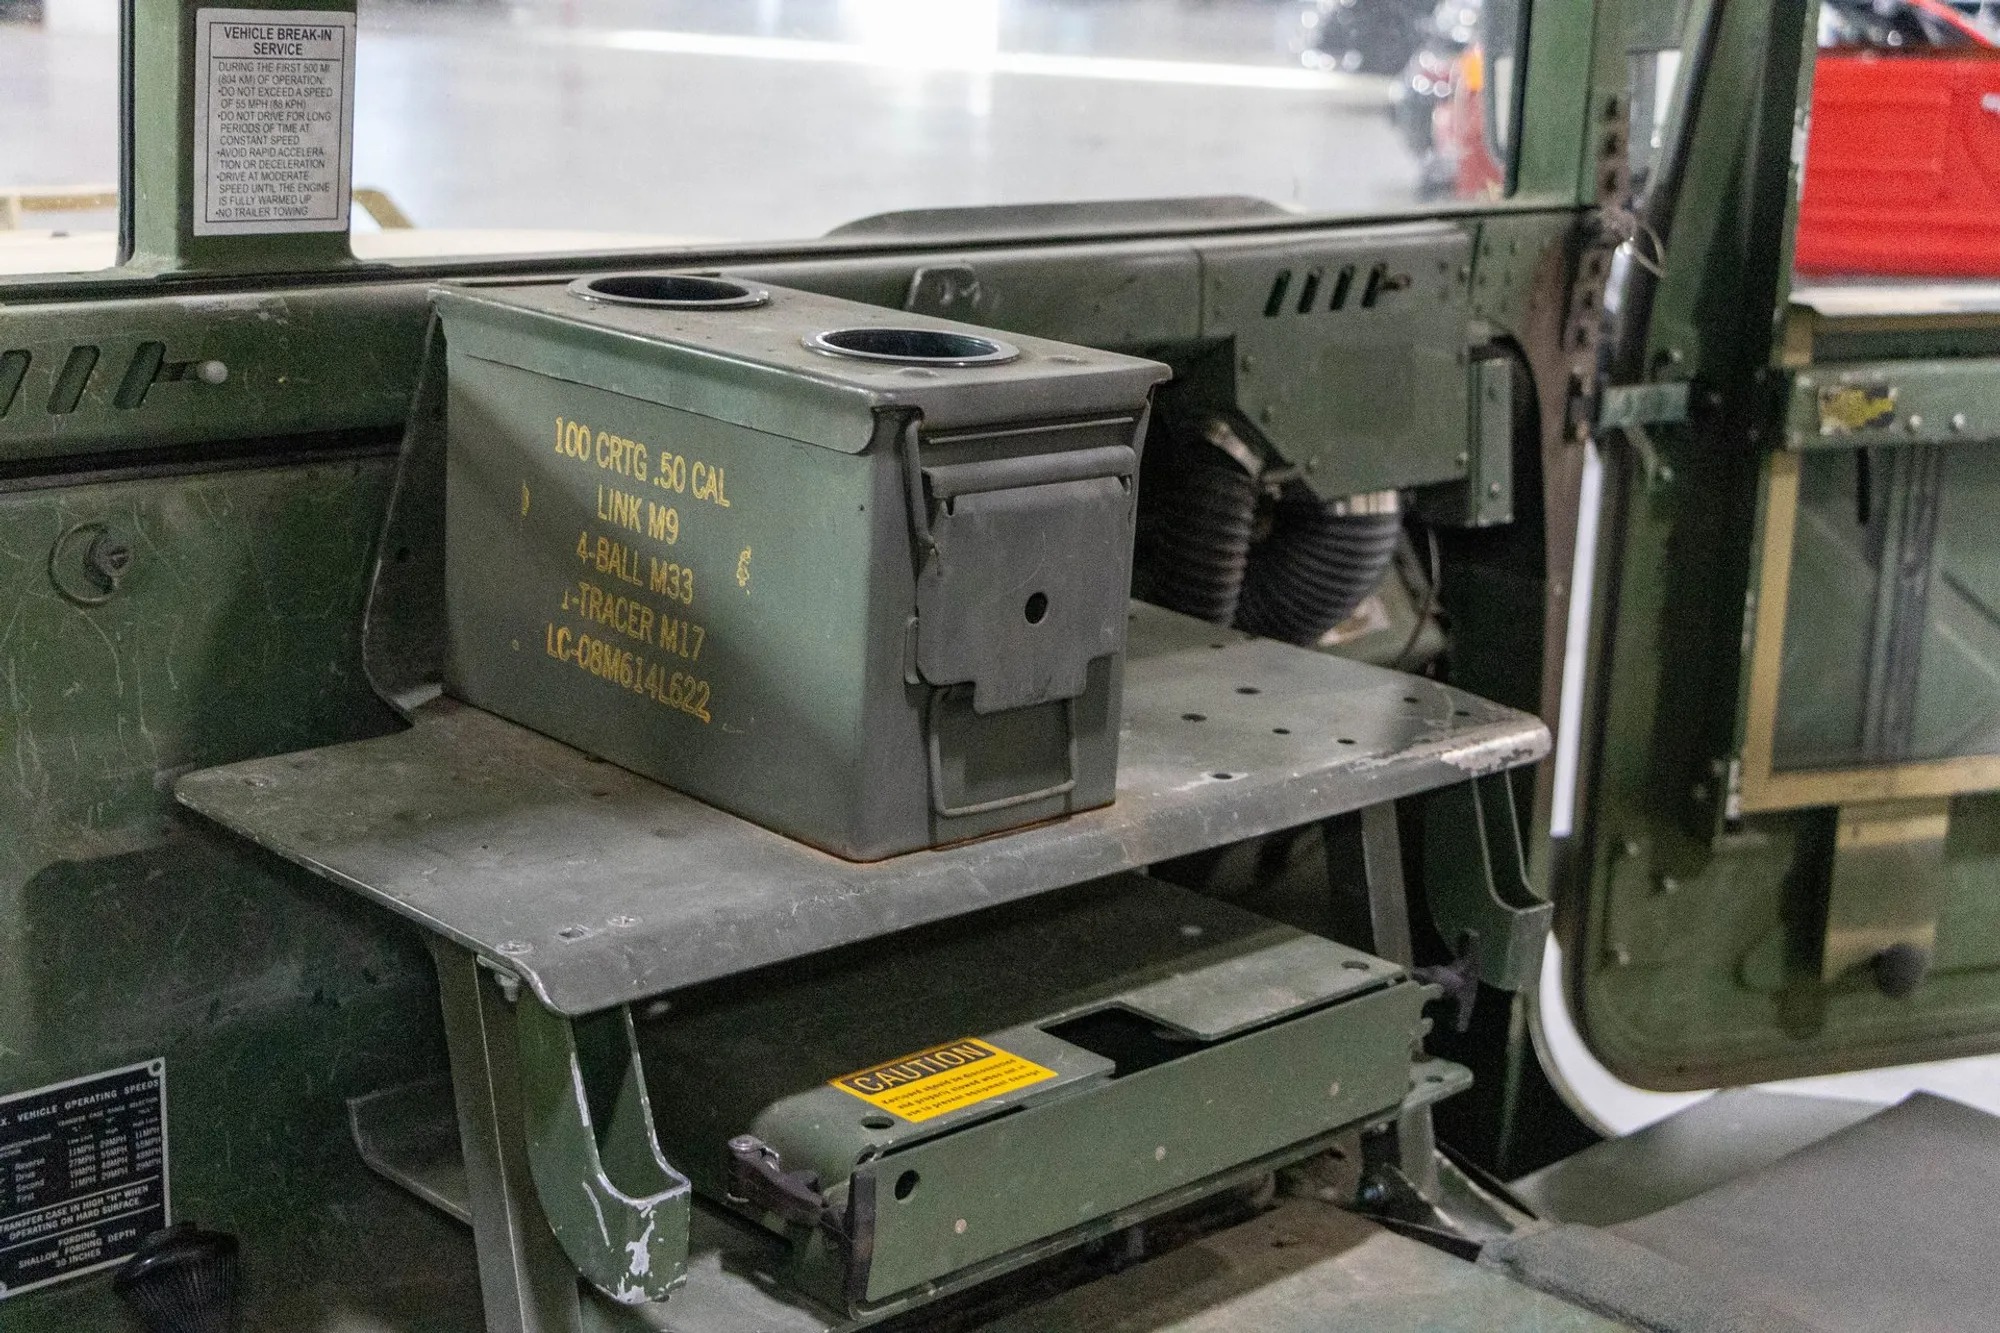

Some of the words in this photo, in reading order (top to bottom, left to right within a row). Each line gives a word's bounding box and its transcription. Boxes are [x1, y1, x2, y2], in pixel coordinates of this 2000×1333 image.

[224, 26, 274, 40] VEHICLE
[277, 28, 332, 41] BREAK-IN
[253, 42, 303, 55] SERVICE
[218, 62, 253, 73] DURING
[256, 62, 274, 73] THE
[276, 63, 300, 73] FIRST
[304, 63, 318, 73] 500
[257, 75, 270, 85] OF
[237, 87, 255, 97] NOT
[258, 87, 294, 97] EXCEED
[295, 88, 303, 97] A
[304, 87, 333, 97] SPEED
[221, 99, 233, 109] OF
[235, 99, 246, 109] 55
[249, 99, 267, 109] MPH
[285, 99, 307, 110] KPH)
[236, 111, 255, 121] NOT
[258, 111, 284, 121] DRIVE
[286, 112, 305, 121] FOR
[307, 112, 331, 122] LONG
[220, 123, 261, 133] PERIODS
[263, 123, 275, 133] OF
[278, 123, 298, 133] TIME
[300, 123, 310, 133] AT
[219, 135, 267, 145] CONSTANT
[270, 135, 300, 145] SPEED
[249, 148, 277, 157] RAPID
[220, 160, 241, 169] TION
[243, 160, 256, 169] OR
[259, 159, 325, 169] DECELERATION
[248, 172, 259, 181] AT
[261, 171, 309, 181] MODERATE
[219, 184, 249, 194] SPEED
[251, 184, 277, 193] UNTIL
[279, 183, 295, 192] THE
[297, 183, 330, 192] ENGINE
[218, 196, 227, 206] IS
[229, 196, 256, 205] FULLY
[258, 195, 298, 205] WARMED
[300, 195, 312, 204] UP
[235, 208, 270, 217] TRAILER
[273, 206, 308, 217] TOWING
[554, 416, 591, 462] 100
[596, 431, 647, 482] CRTG
[653, 452, 687, 494] .50
[691, 461, 731, 508] CAL
[597, 484, 643, 533] LINK
[648, 502, 680, 545] M9
[576, 531, 643, 587] 4-BALL
[650, 556, 693, 605] M33
[660, 614, 706, 661] M17
[546, 622, 712, 724] LC-08M614L622
[853, 1044, 988, 1092] CAUTION
[17, 1104, 58, 1122] VEHICLE
[64, 1089, 117, 1110] OPERATING
[124, 1079, 159, 1095] SPEEDS
[45, 1207, 68, 1220] CASE
[70, 1203, 81, 1212] IN
[82, 1197, 104, 1210] HIGH
[124, 1184, 149, 1197] WHEN
[9, 1222, 58, 1241] OPERATING
[60, 1215, 74, 1225] ON
[76, 1208, 100, 1221] HARD
[102, 1197, 140, 1215] SURFACE
[58, 1230, 97, 1247] FORDING
[18, 1250, 59, 1269] SHALLOW
[64, 1238, 103, 1255] FORDING
[107, 1228, 136, 1243] DEPTH
[69, 1248, 101, 1264] INCHES
